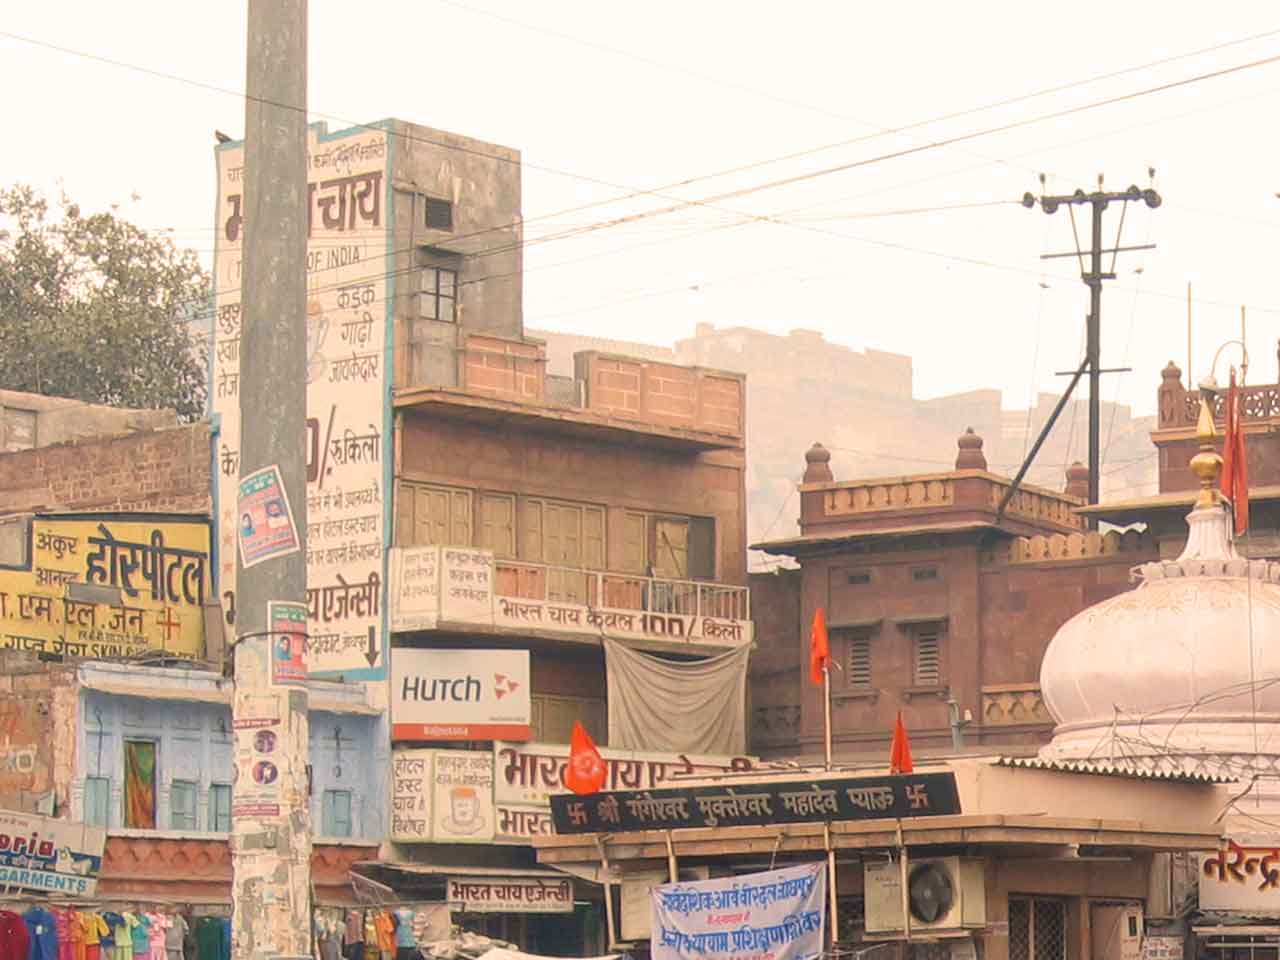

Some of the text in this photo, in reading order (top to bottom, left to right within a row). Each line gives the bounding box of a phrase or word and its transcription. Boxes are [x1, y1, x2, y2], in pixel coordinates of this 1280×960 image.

[327, 247, 361, 270] INDIA
[322, 571, 380, 622] एजेन्सी
[500, 599, 543, 621] भारत
[547, 606, 581, 627] चाय
[783, 784, 838, 817] महादेव
[0, 868, 87, 892] GARMENTS
[451, 879, 571, 904] भारत चाय एजेन्सी
